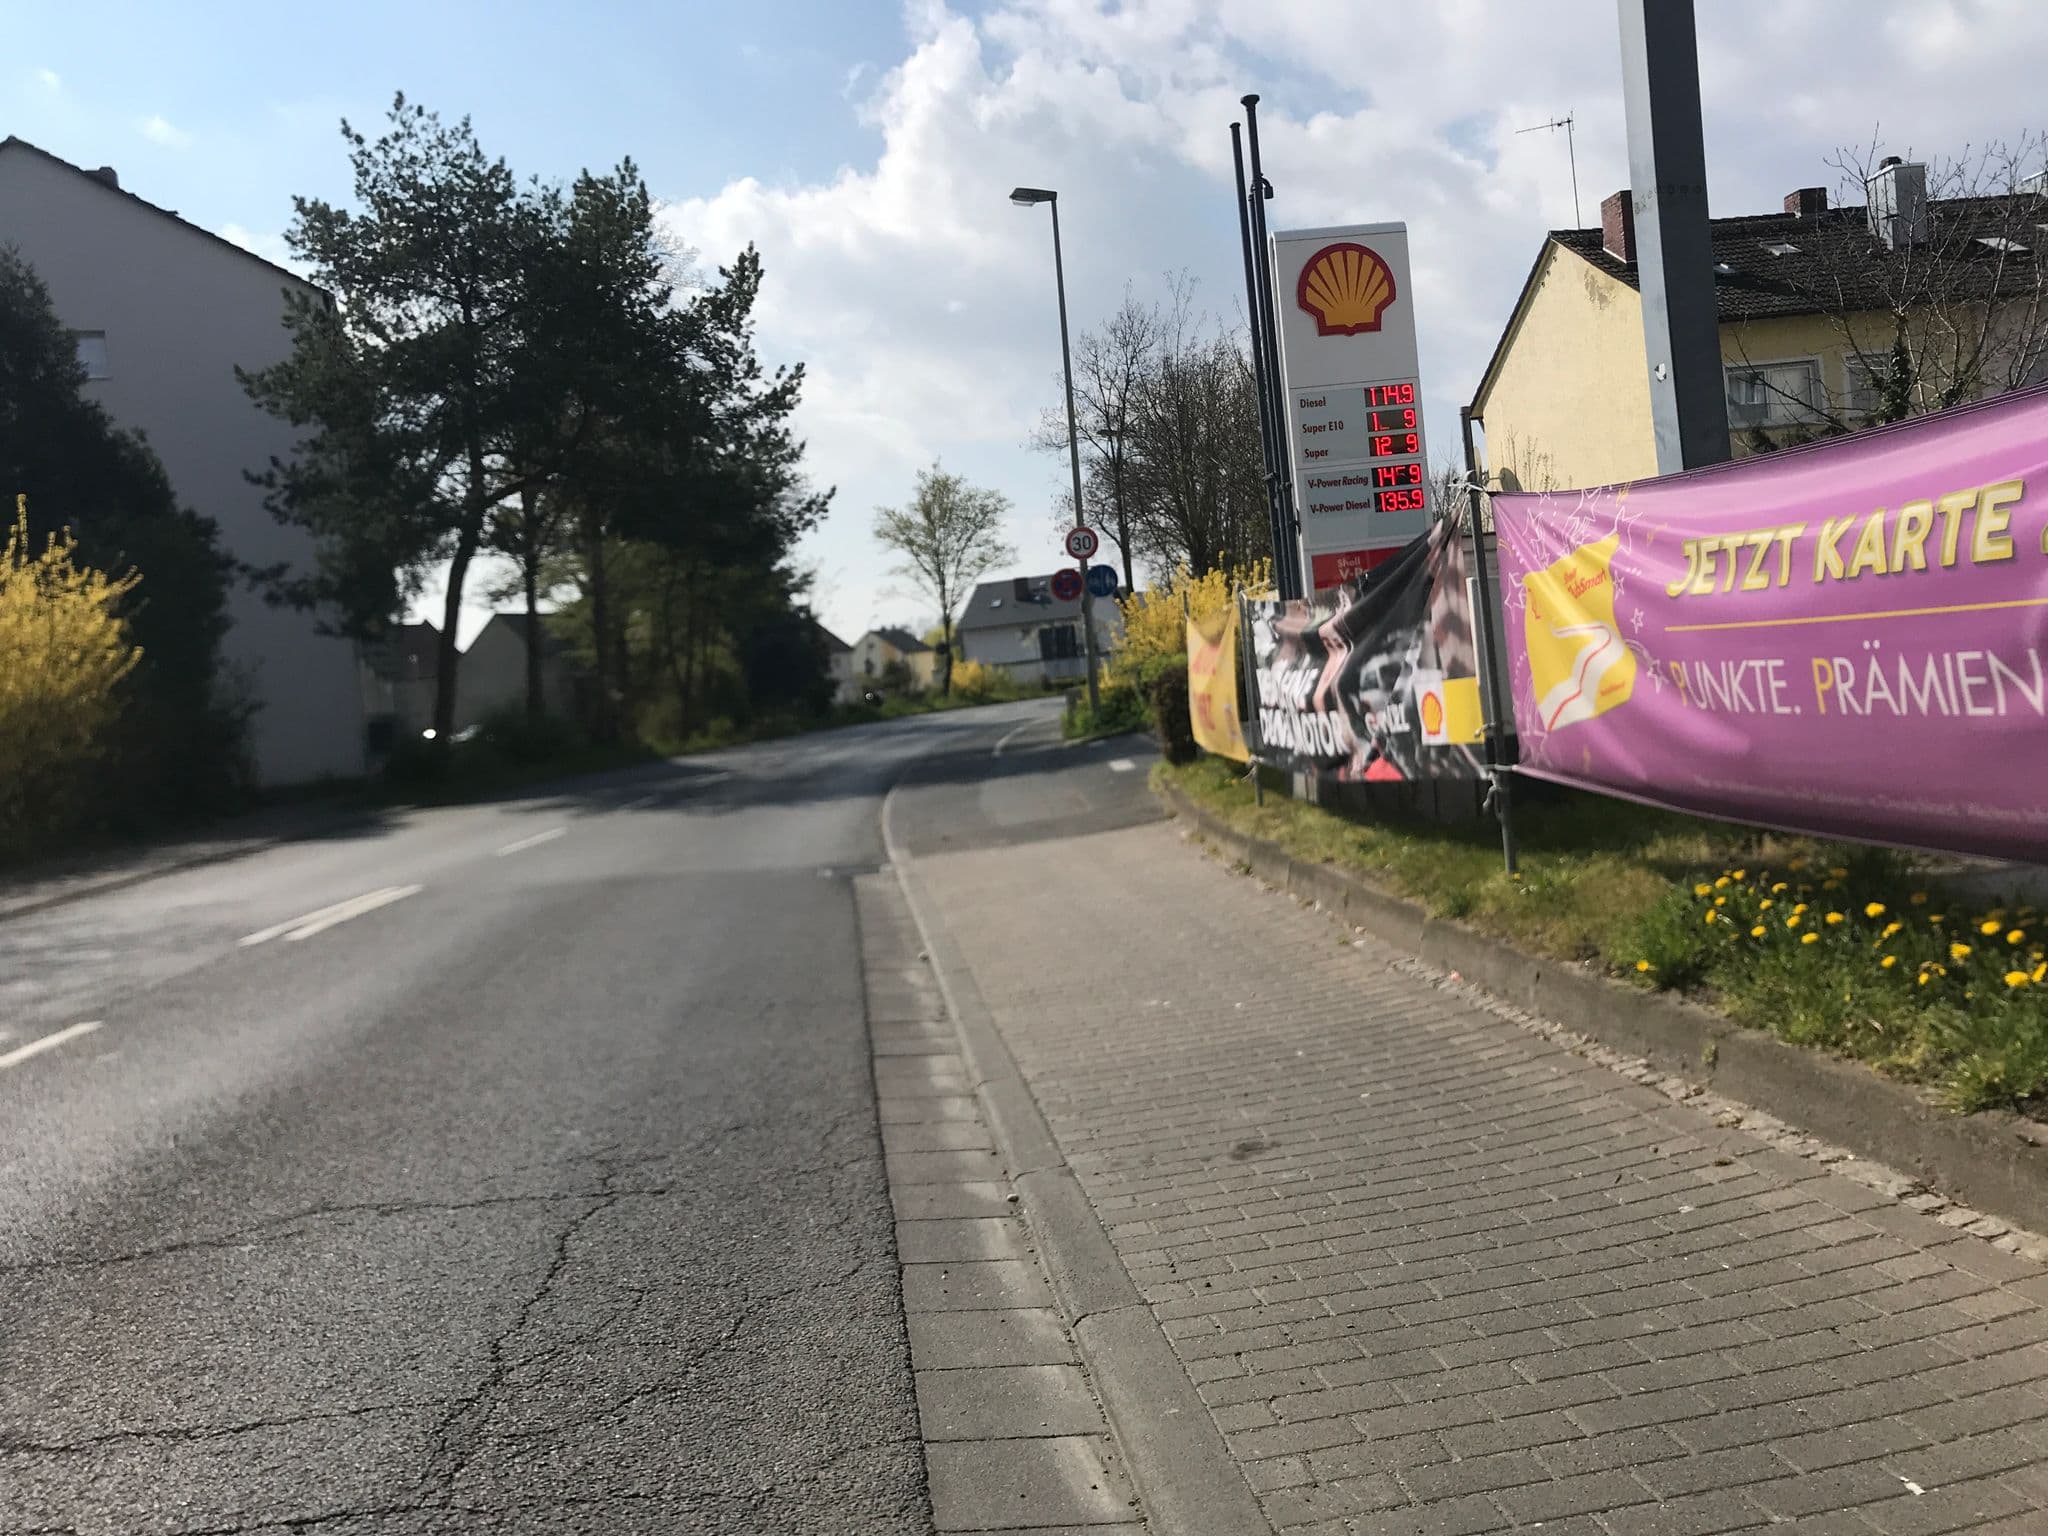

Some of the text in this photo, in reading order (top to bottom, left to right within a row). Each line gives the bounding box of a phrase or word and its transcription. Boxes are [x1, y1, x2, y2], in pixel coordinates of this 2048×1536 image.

[1300, 397, 1327, 409] Diesel
[1302, 424, 1326, 435] Super
[1328, 421, 1344, 431] E10
[1305, 448, 1329, 460] Super
[1307, 478, 1342, 489] V-Power
[1342, 475, 1369, 487] Racing
[1310, 503, 1344, 514] V-Power
[1345, 498, 1371, 510] Diesel
[1072, 535, 1092, 552] 30
[1665, 479, 2025, 599] JETZT KARTE
[1336, 556, 1361, 569] Shell
[1669, 639, 2046, 718] PUNKTE. PRÄMIEN
